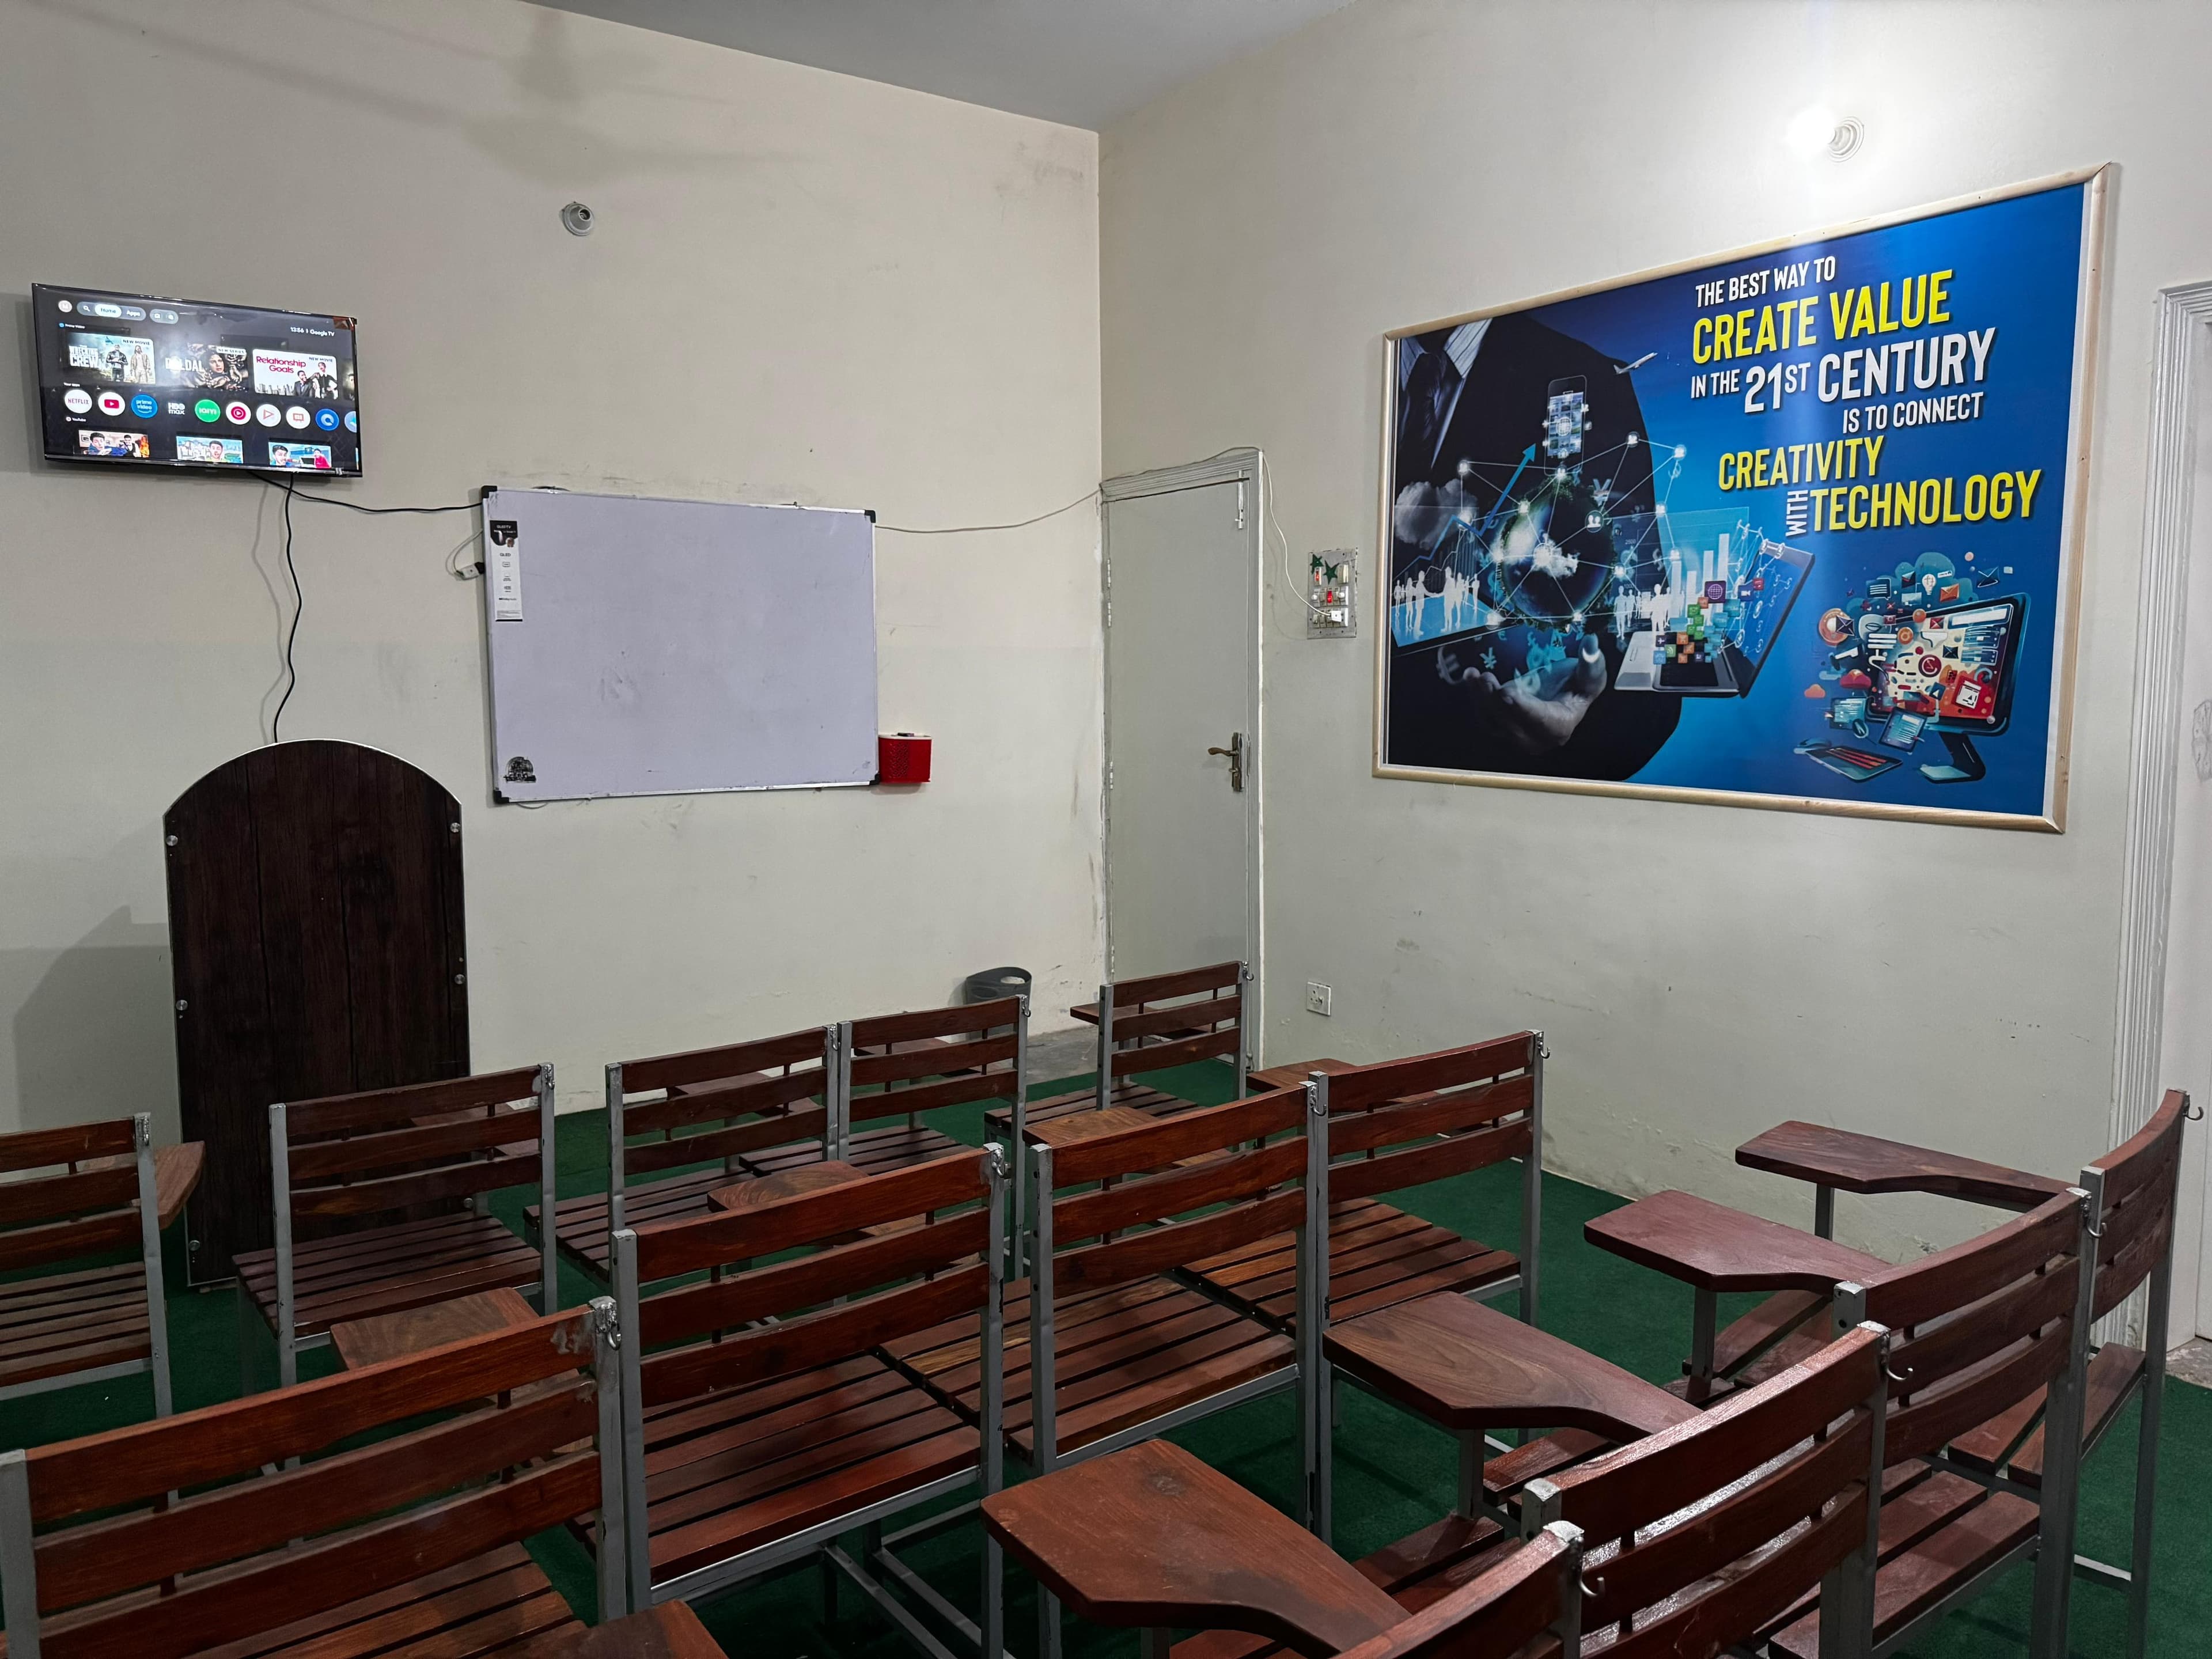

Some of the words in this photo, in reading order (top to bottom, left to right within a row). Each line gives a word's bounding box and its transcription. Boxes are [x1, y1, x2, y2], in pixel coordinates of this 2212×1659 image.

[1695, 280, 1725, 307] THE
[1729, 270, 1770, 301] BEST
[1774, 261, 1810, 291] WAY
[1814, 256, 1836, 283] TO
[1693, 296, 1819, 364] CREATE
[1830, 269, 1952, 340] VALUE
[69, 355, 99, 368] CREW
[256, 356, 306, 368] Relationship
[269, 365, 294, 373] Goals
[1691, 374, 1706, 399] IN
[1710, 369, 1740, 396] THE
[1745, 362, 1810, 413] 21ST
[1818, 327, 1996, 402] CENTURY
[1843, 408, 1859, 434] IS
[1865, 402, 1888, 430] TO
[1893, 392, 1984, 427] CONNECT
[1719, 435, 1884, 491] CREATIVITY
[1786, 490, 1808, 536] WITH
[1810, 469, 2041, 532] TECHNOLOGY
